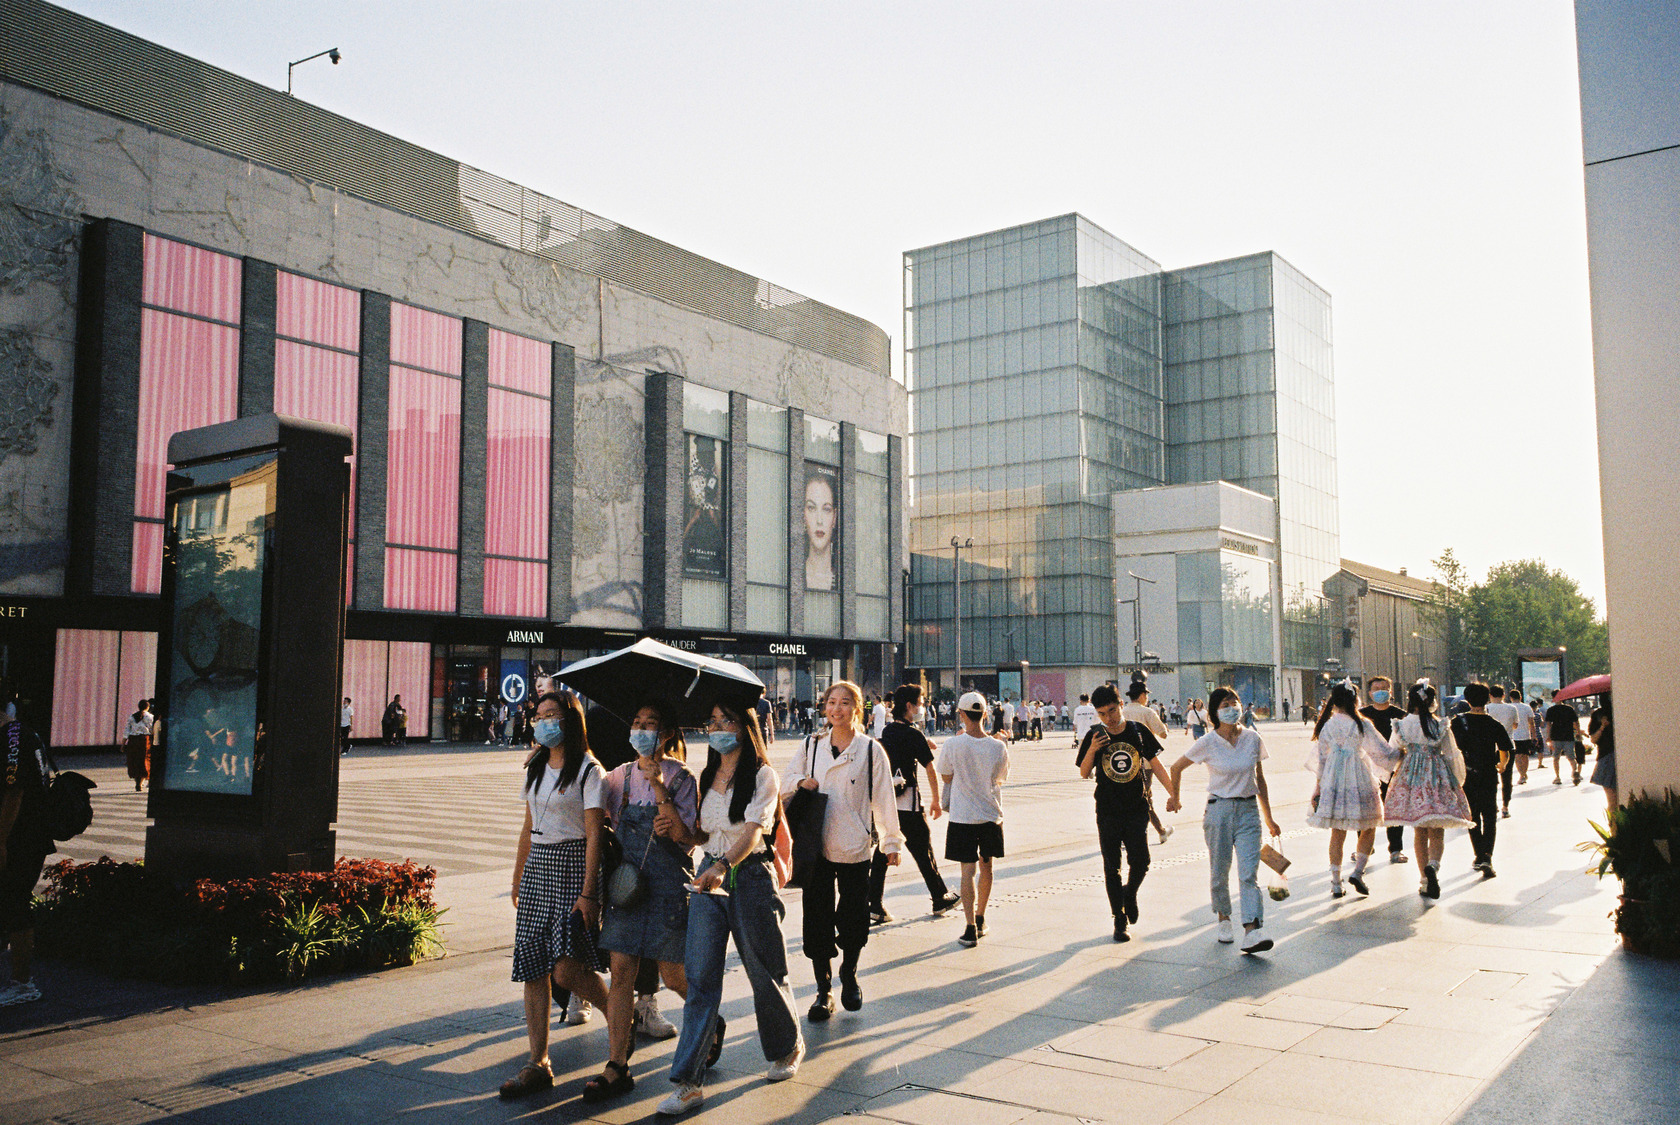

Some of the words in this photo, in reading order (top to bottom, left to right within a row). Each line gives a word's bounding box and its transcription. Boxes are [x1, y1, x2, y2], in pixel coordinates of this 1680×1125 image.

[506, 630, 544, 644] ARMANI
[769, 643, 807, 655] CHANEL
[1122, 666, 1142, 674] LOU
